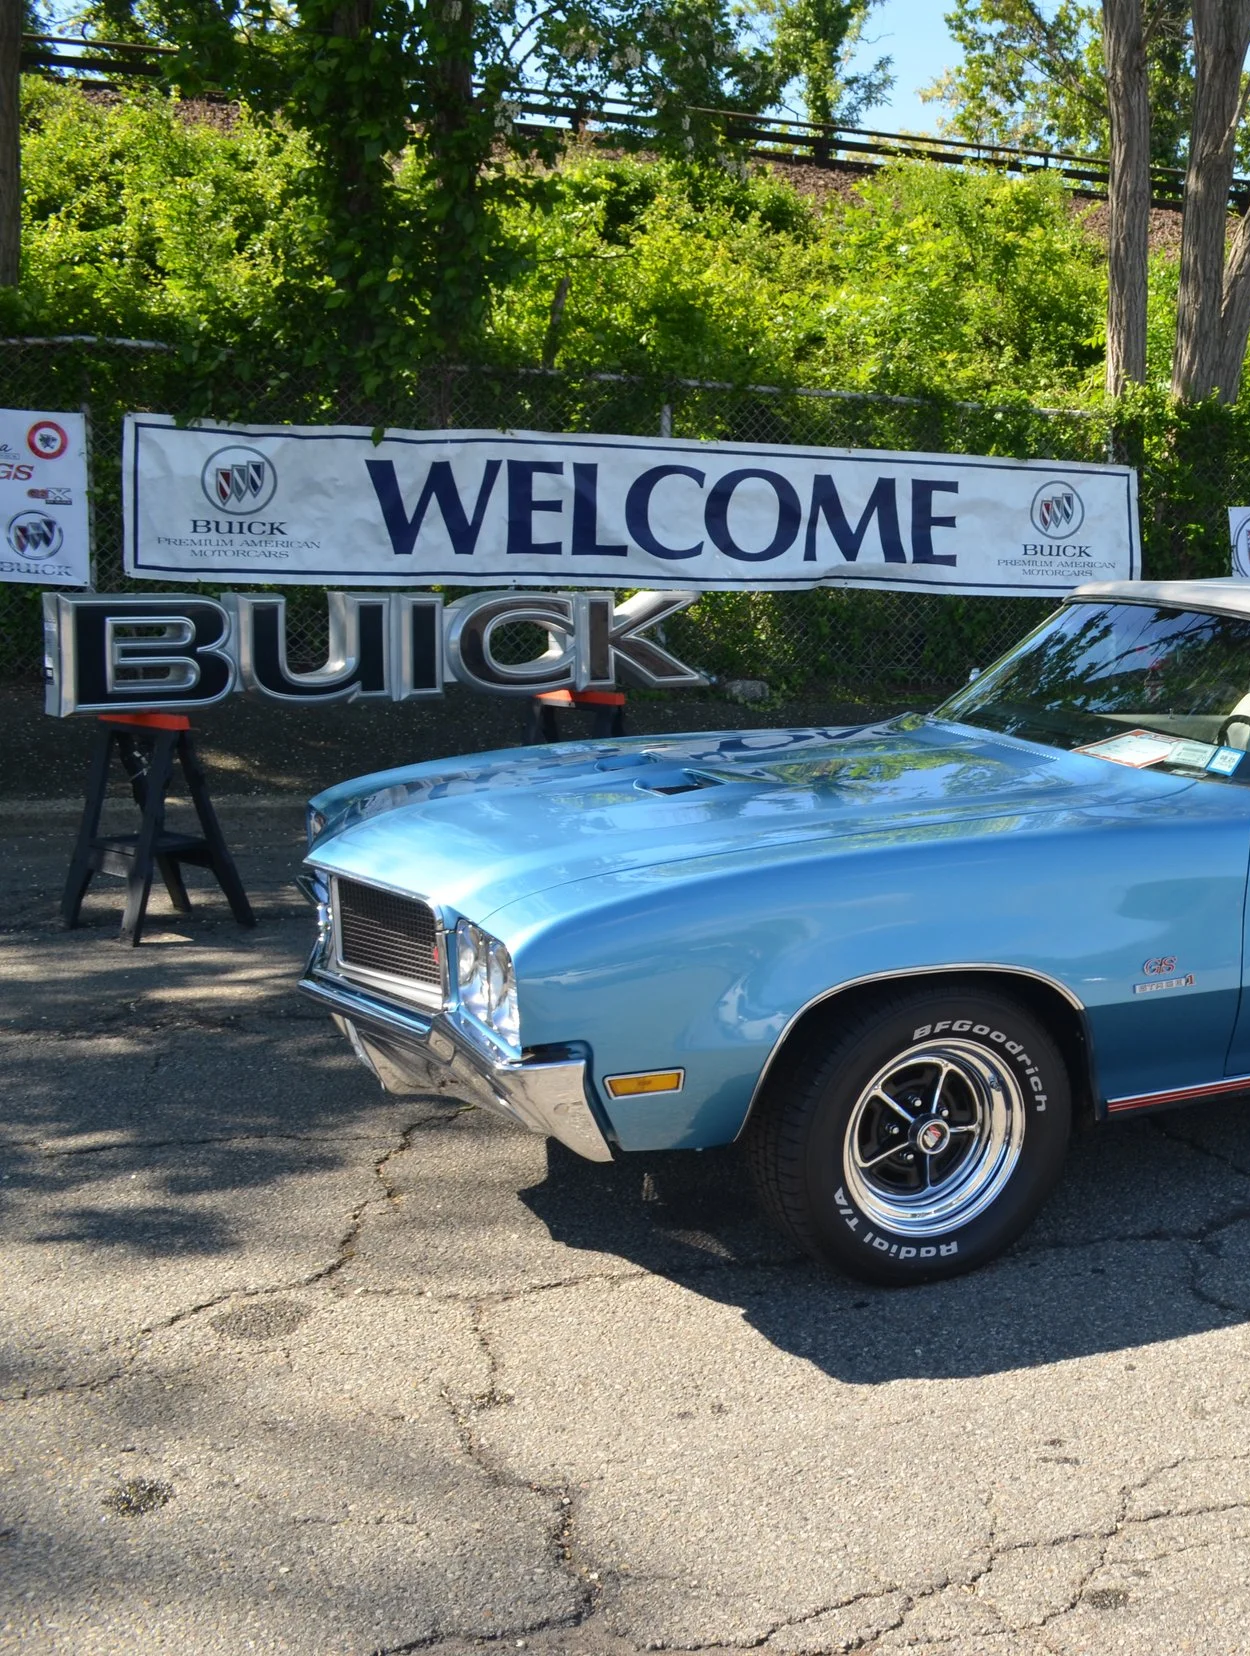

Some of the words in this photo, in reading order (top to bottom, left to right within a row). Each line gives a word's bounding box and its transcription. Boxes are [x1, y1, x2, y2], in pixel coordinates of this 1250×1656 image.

[365, 458, 960, 568] WELCOME
[190, 519, 288, 536] BUICK
[157, 536, 234, 548] PREMIUM
[239, 538, 321, 549] AMERICAN
[1022, 543, 1093, 558] BUICK
[190, 549, 290, 559] MOTORCARS
[0, 561, 73, 577] BUICK
[997, 559, 1053, 568] PREMIUM
[1056, 560, 1117, 569] AMERICAN
[1021, 568, 1094, 577] MOTORCARS
[42, 591, 712, 718] BUICK
[1143, 955, 1178, 977] GS
[1136, 979, 1184, 993] STAGE
[1185, 973, 1195, 986] 1
[912, 1020, 1048, 1113] BFGoodrich
[833, 1186, 860, 1233] T/A
[863, 1231, 960, 1260] Radial
